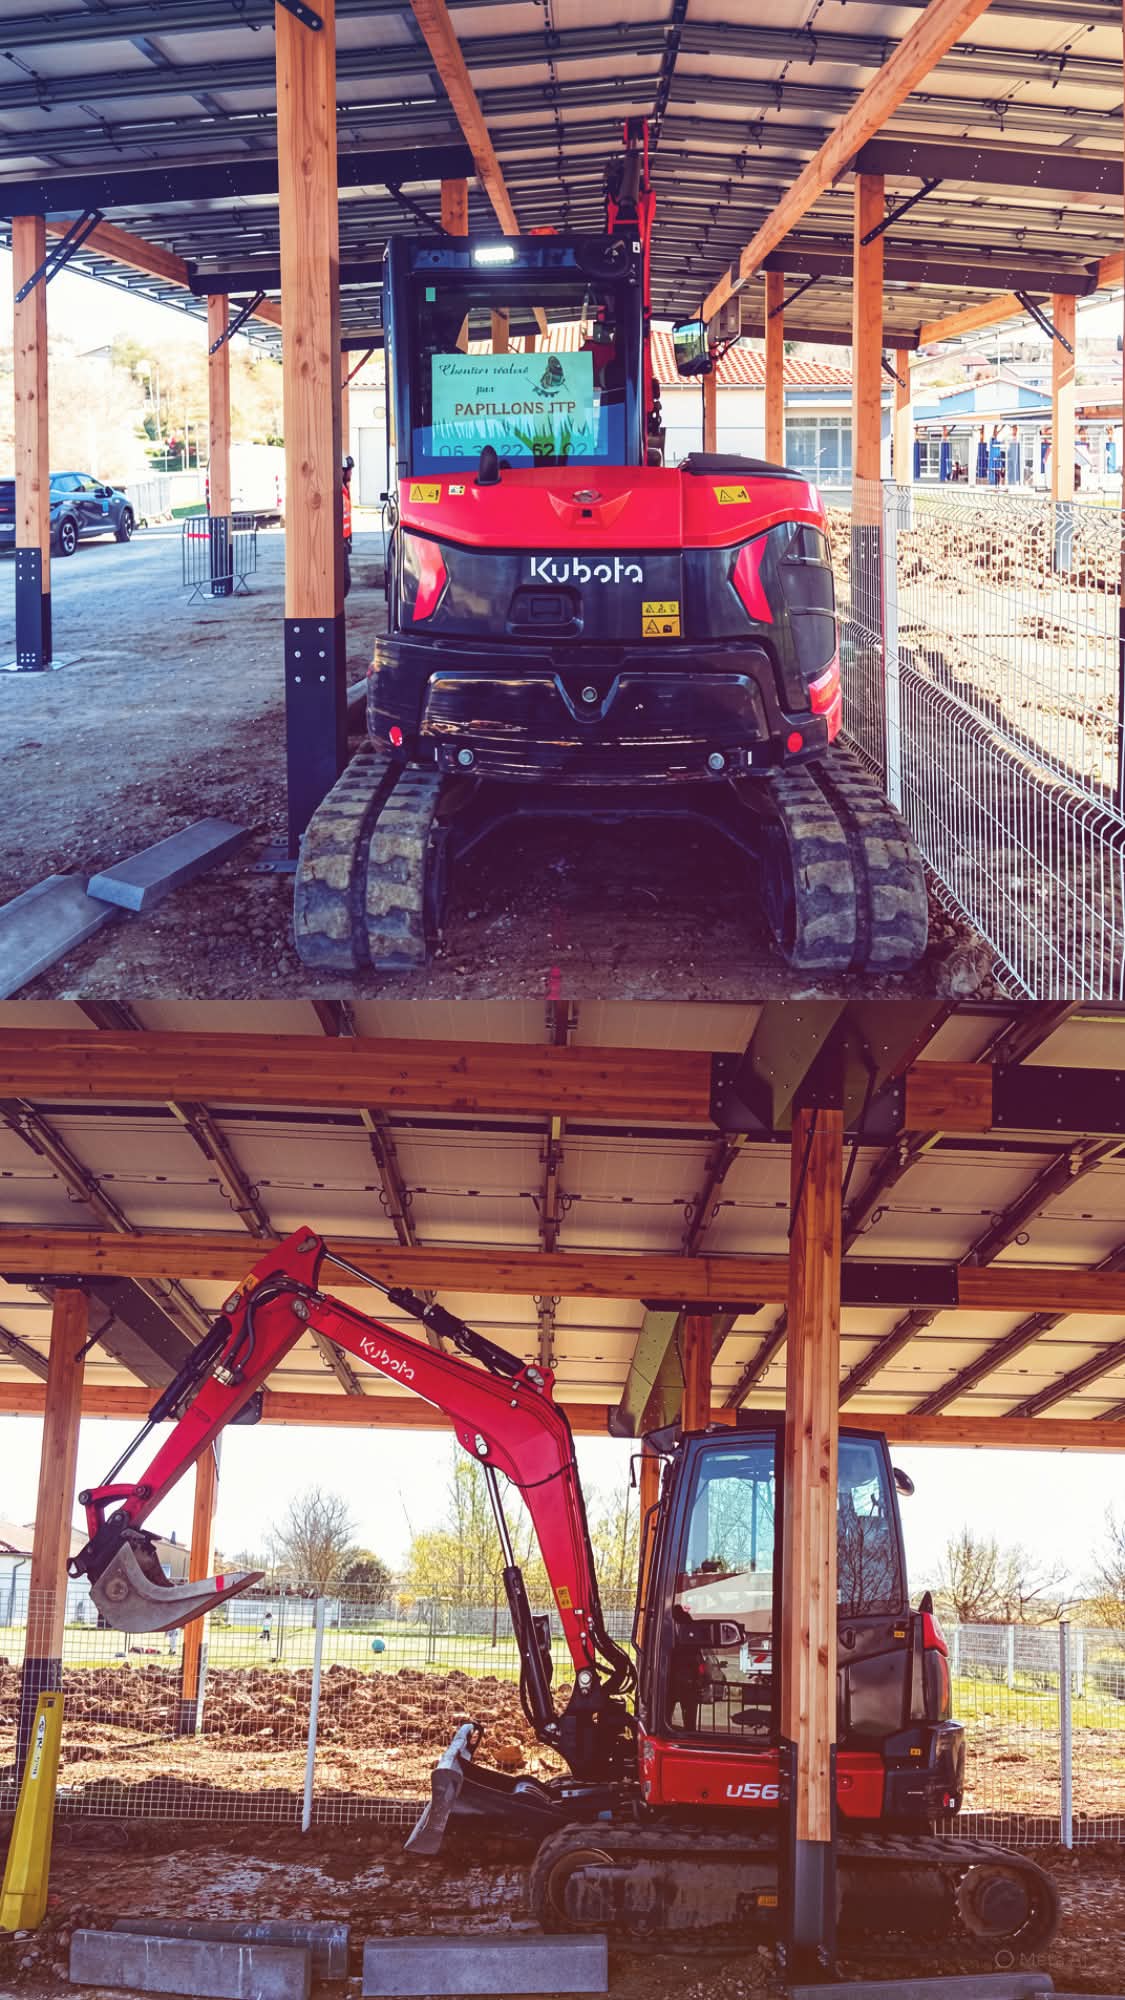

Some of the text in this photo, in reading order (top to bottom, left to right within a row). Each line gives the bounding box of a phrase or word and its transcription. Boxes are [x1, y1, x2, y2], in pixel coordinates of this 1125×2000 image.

[475, 386, 494, 396] par
[455, 401, 576, 416] PAPILLONS JTP
[530, 557, 643, 583] Kubota
[360, 1337, 415, 1380] Kubota
